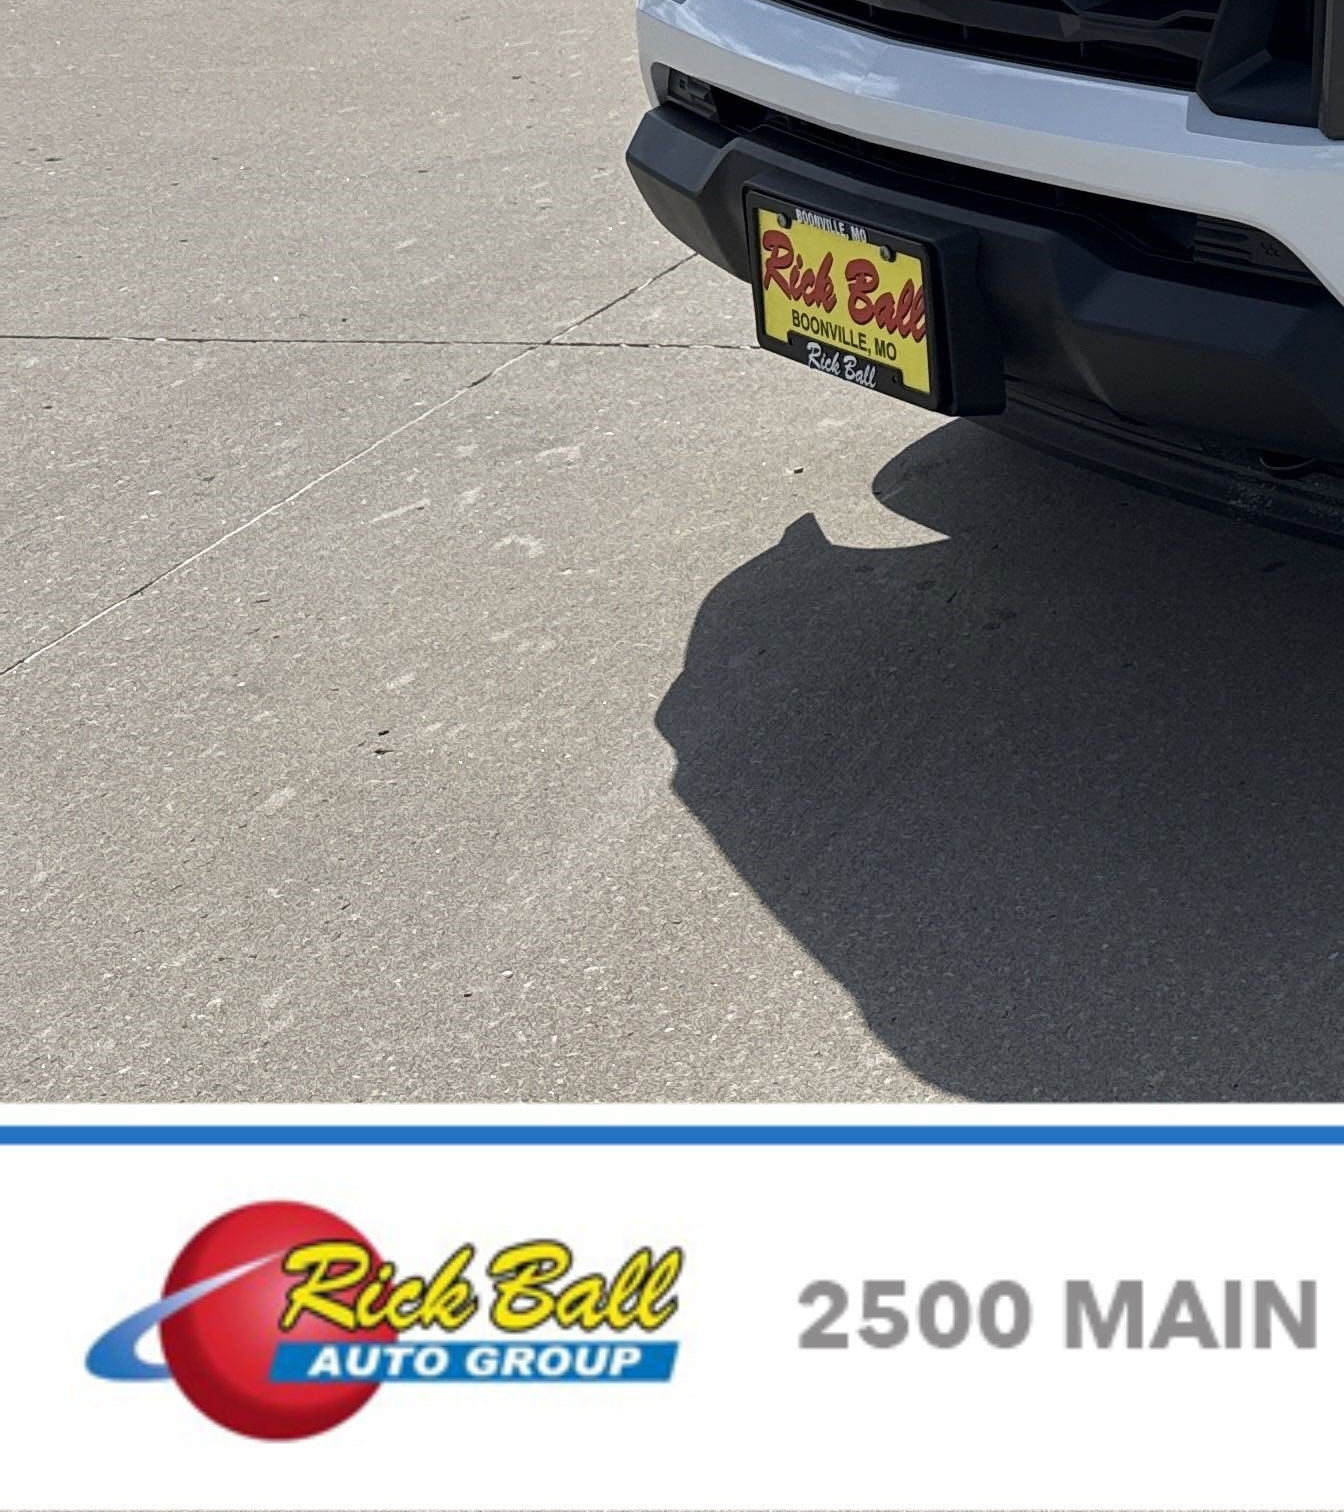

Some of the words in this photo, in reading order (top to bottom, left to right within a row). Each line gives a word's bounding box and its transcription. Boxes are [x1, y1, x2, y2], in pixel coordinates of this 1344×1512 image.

[796, 209, 850, 240] BOONVILLE,
[851, 226, 868, 244] MO
[762, 229, 838, 314] Rick
[845, 258, 926, 343] Ball
[791, 309, 872, 357] BOONVILLE,
[875, 338, 898, 361] MO
[806, 341, 841, 377] Rick
[844, 355, 877, 389] Ball
